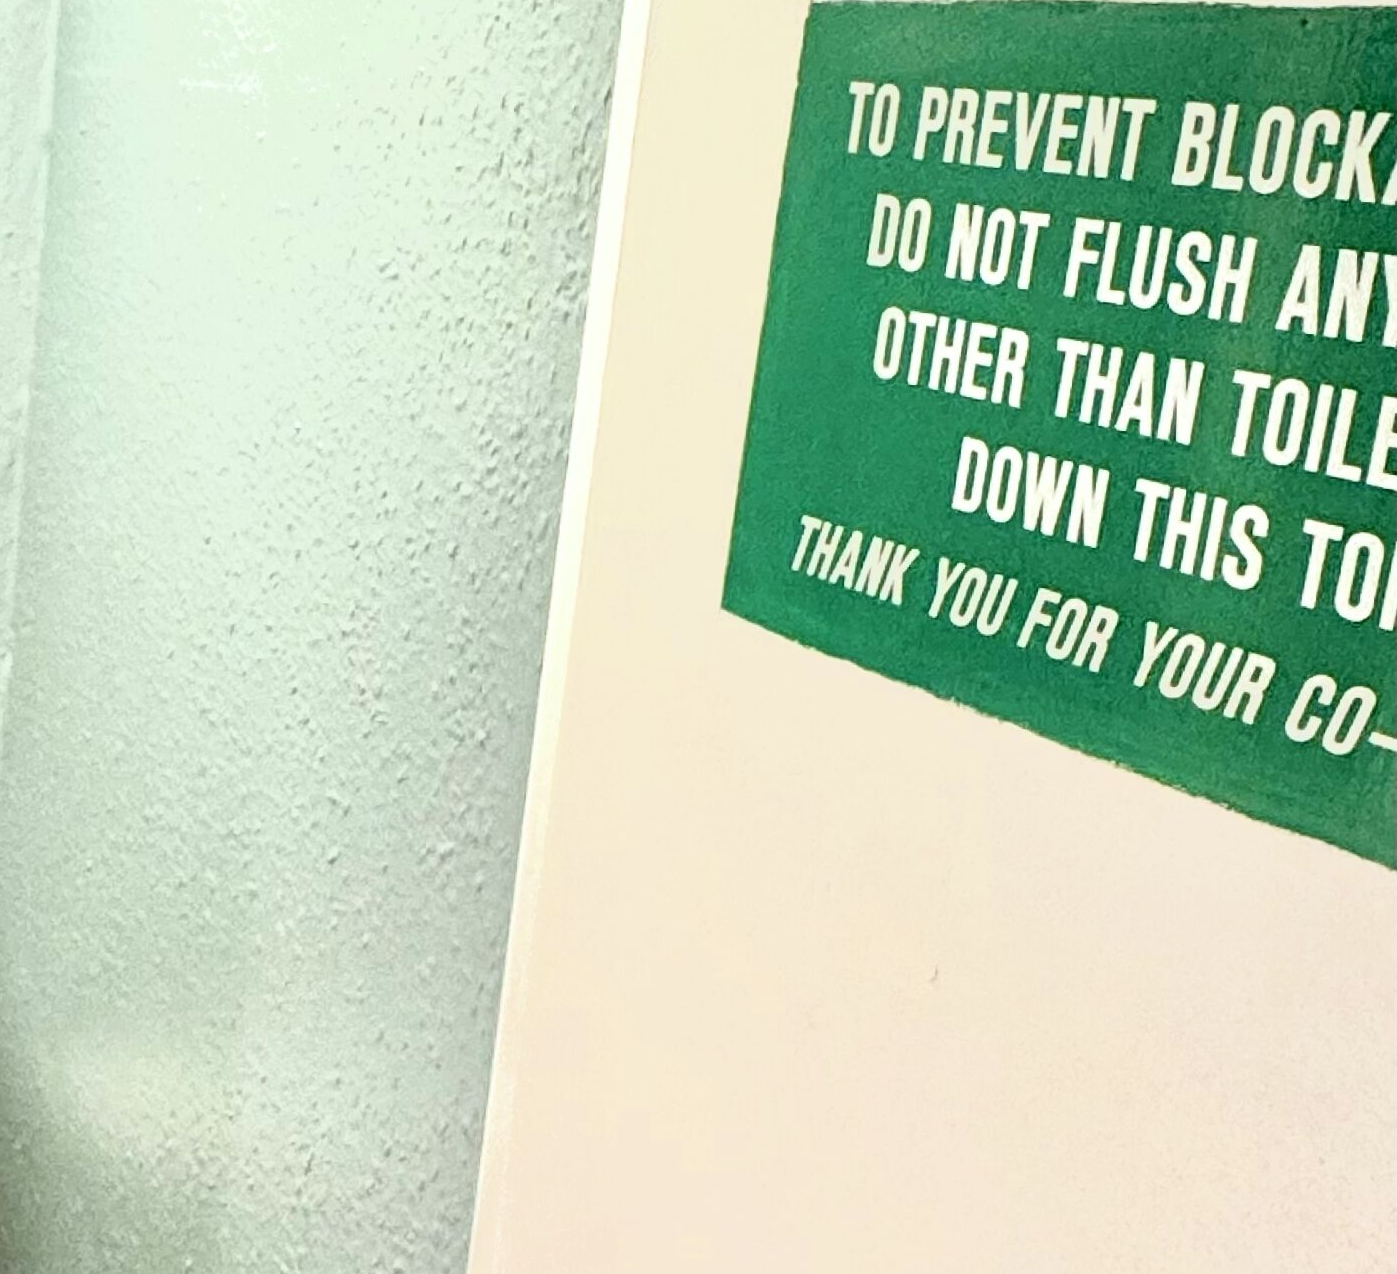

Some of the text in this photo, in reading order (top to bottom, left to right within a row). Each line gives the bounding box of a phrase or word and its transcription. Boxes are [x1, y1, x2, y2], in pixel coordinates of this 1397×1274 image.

[848, 81, 1397, 205] TO PREVENT BLOCK
[867, 194, 931, 272] DO
[945, 203, 1050, 289] NOT
[1063, 218, 1258, 323] FLUSH
[874, 306, 1029, 408] OTHER
[1055, 338, 1204, 445] THAN
[952, 437, 1109, 548] DOWN
[1134, 479, 1269, 589] THIS
[792, 515, 919, 605] THANK
[929, 557, 1018, 635] YOU
[1018, 588, 1118, 672] FOR
[1134, 622, 1275, 724] YOUR
